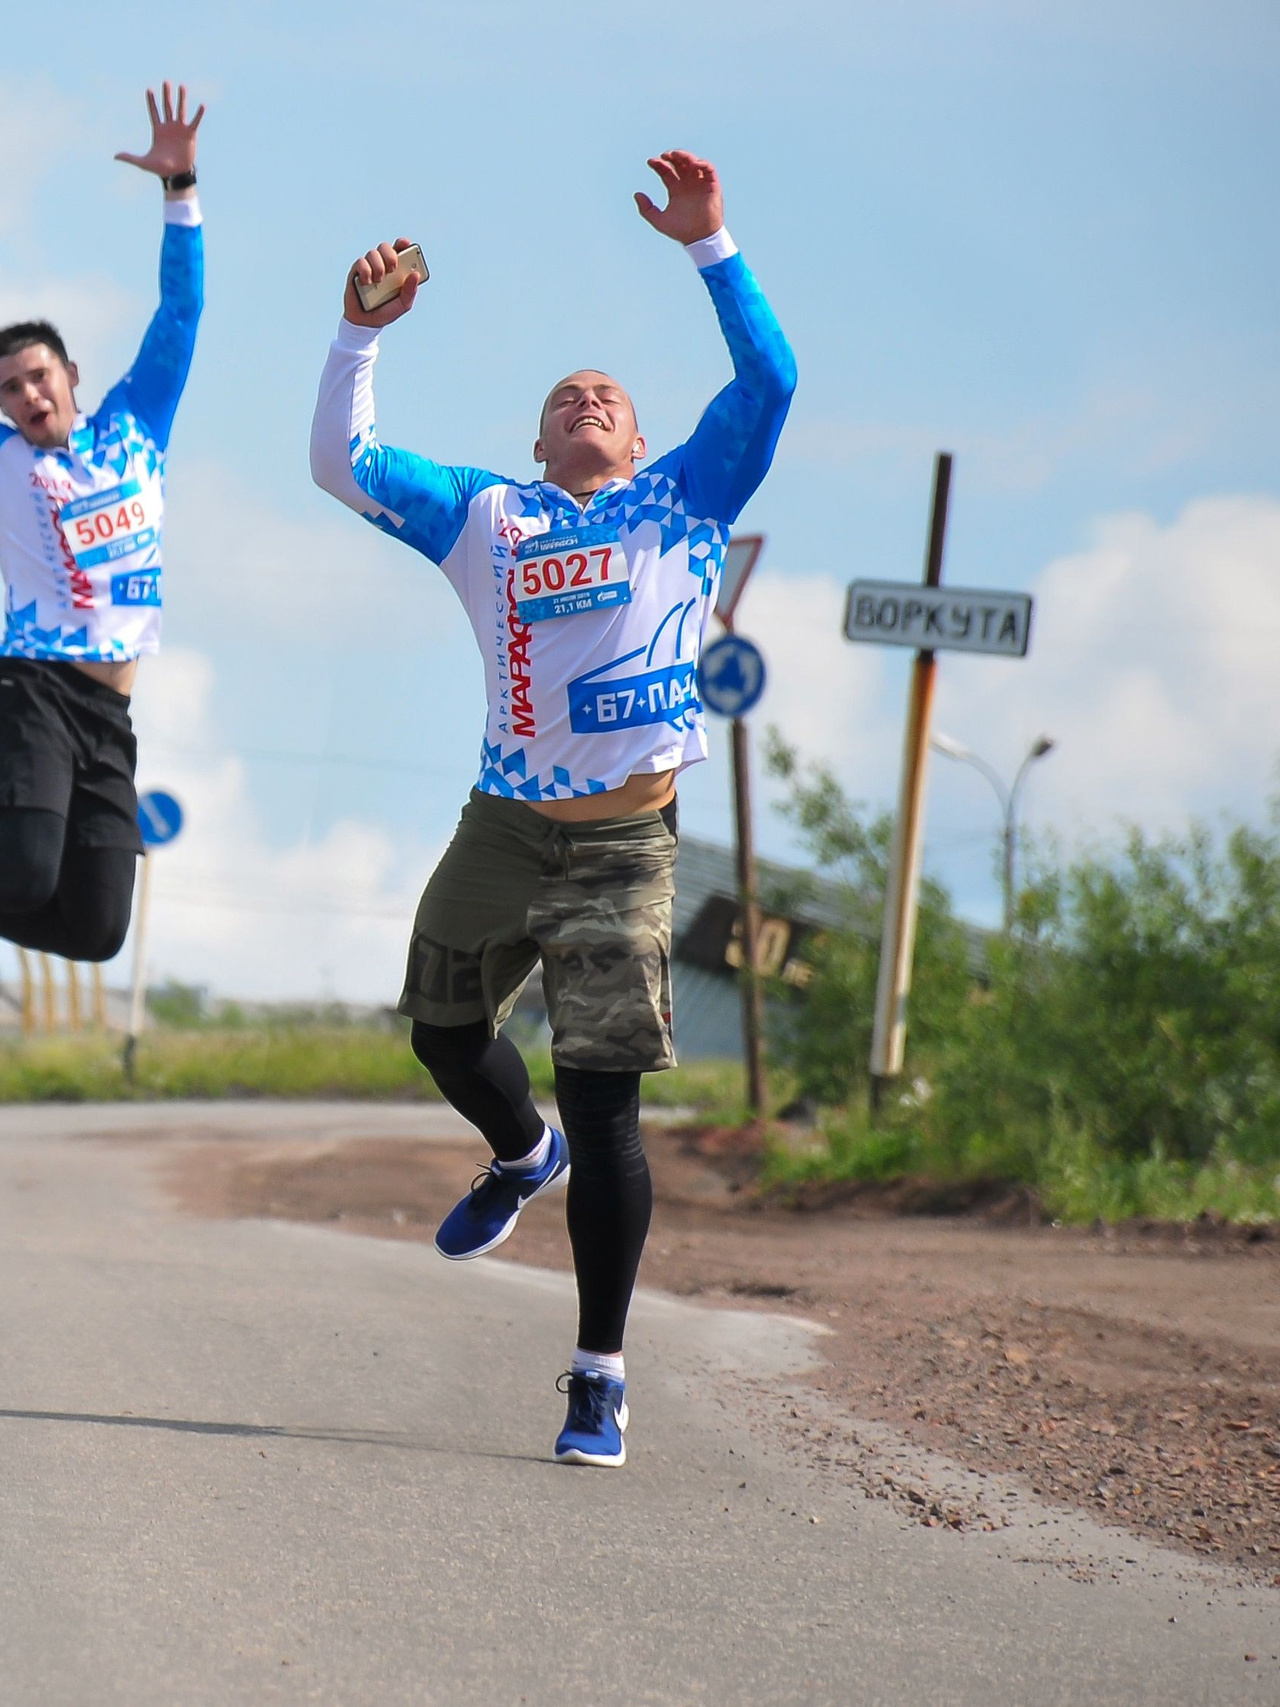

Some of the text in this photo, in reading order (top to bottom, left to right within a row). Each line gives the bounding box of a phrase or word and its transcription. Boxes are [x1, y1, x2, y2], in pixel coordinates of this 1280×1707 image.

[75, 501, 145, 546] 5049
[521, 546, 613, 596] 5027
[554, 602, 574, 614] 21,1
[854, 595, 1017, 643] ВОРКУТА
